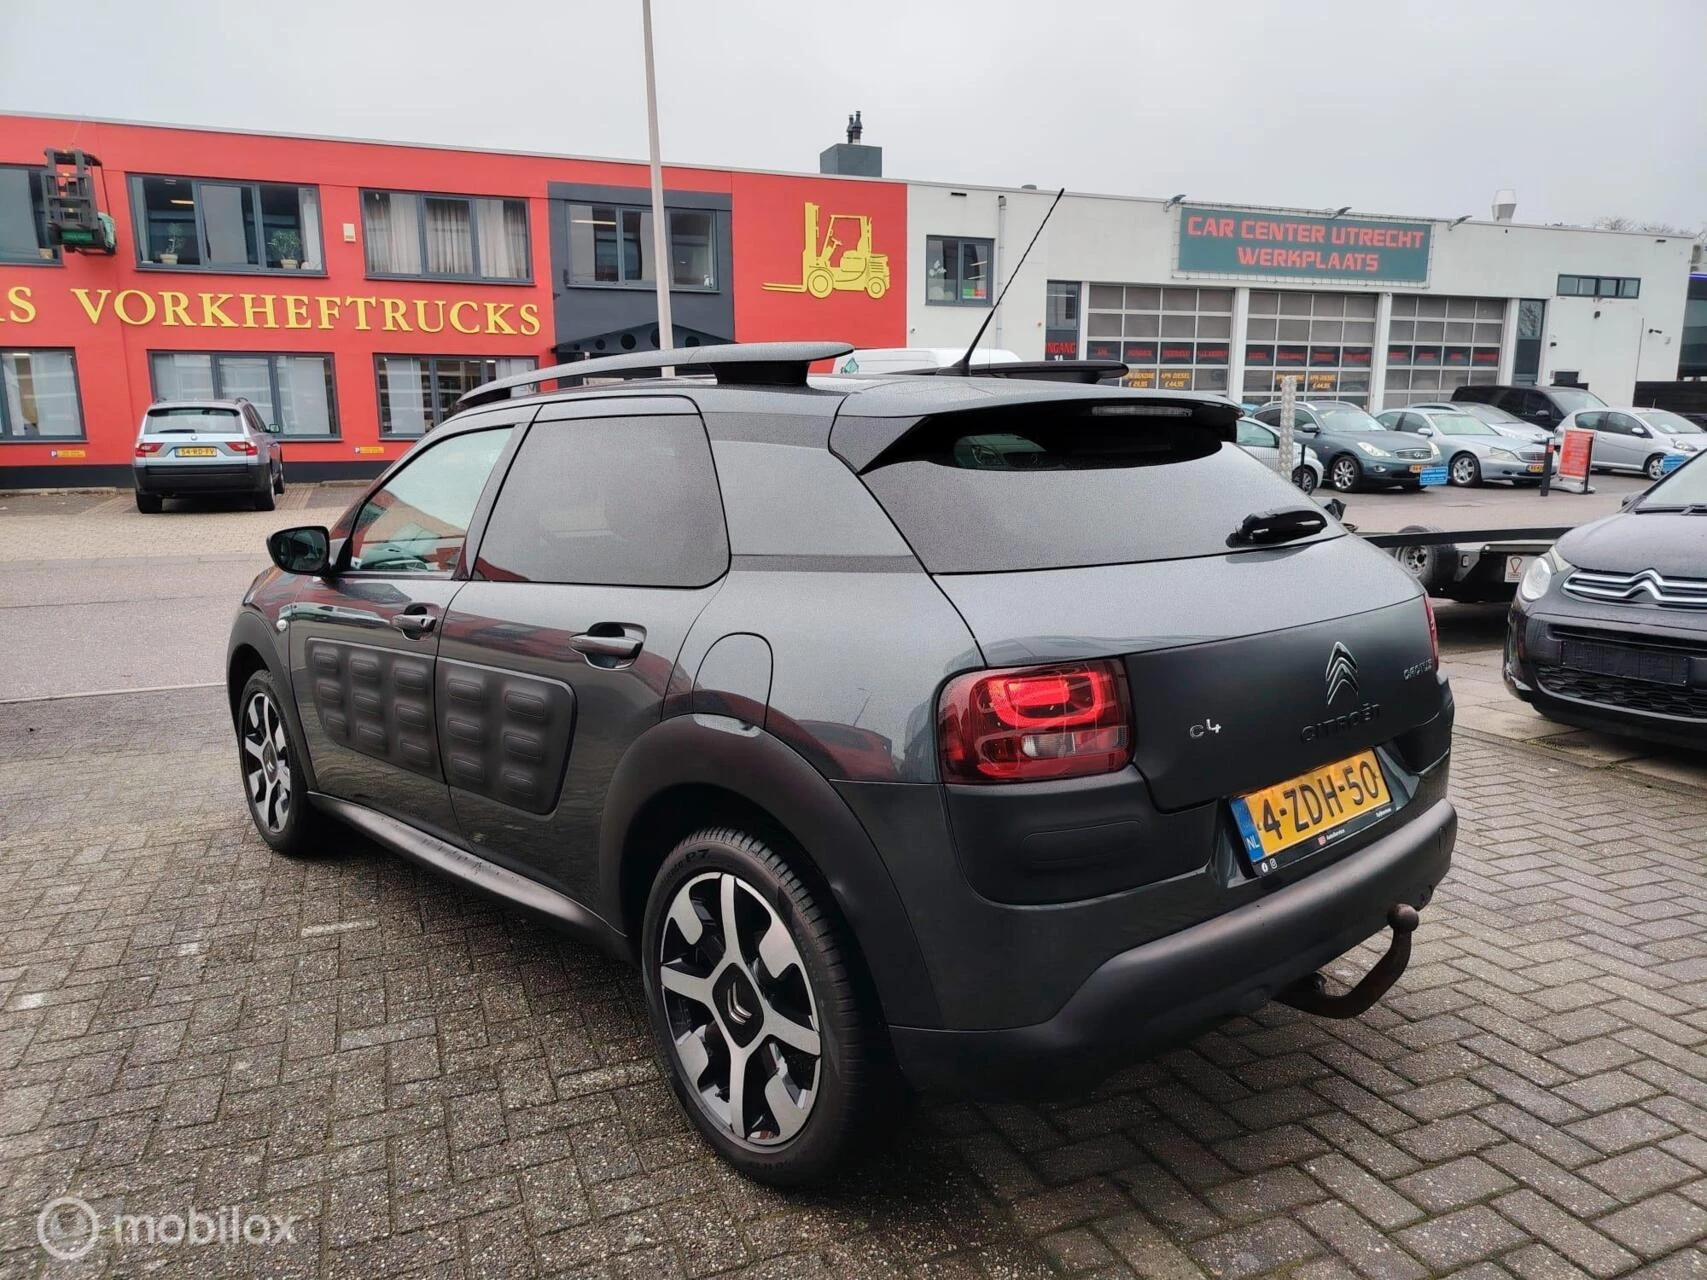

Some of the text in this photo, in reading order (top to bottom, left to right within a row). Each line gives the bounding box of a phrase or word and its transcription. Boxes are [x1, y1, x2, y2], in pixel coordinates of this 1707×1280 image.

[1187, 215, 1424, 249] CAR CENTER UTRECHT
[1237, 247, 1380, 272] WERKPLAATS
[0, 286, 541, 336] S VORKHEFTRUCKS
[1263, 760, 1380, 840] 4-ZDH-50
[1246, 836, 1260, 849] NL
